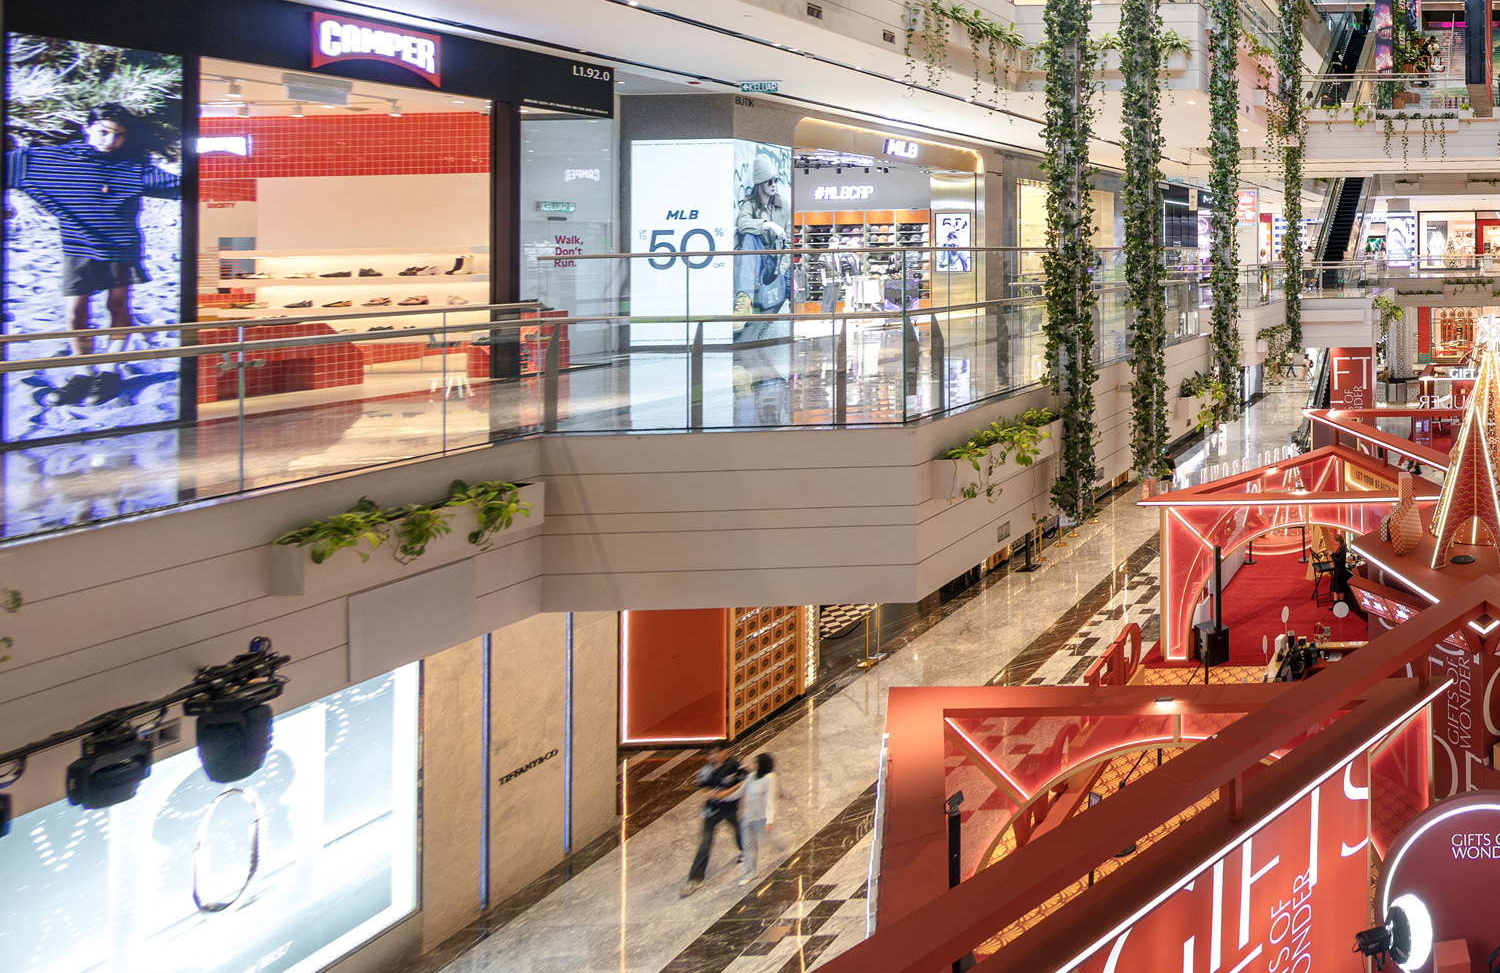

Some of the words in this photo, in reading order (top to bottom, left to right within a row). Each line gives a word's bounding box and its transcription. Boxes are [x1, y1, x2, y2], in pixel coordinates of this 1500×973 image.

[319, 19, 436, 75] CAMPER
[573, 64, 610, 82] L1.92.0
[749, 82, 778, 92] KELUAR
[735, 95, 754, 108] BUTIK
[886, 139, 919, 159] MLB
[813, 185, 874, 200] #MLBCAP
[541, 202, 569, 212] KELUAR
[666, 210, 699, 220] MLB
[555, 235, 584, 245] Walk,
[555, 247, 582, 256] Don't
[554, 259, 577, 267] Run.
[895, 296, 910, 304] MB
[1363, 474, 1374, 486] YOUR
[1447, 656, 1459, 685] OF
[1458, 656, 1472, 748] WONDER
[1448, 690, 1459, 745] GIFTS
[1451, 833, 1491, 847] GIFTS
[1269, 899, 1292, 945] OF
